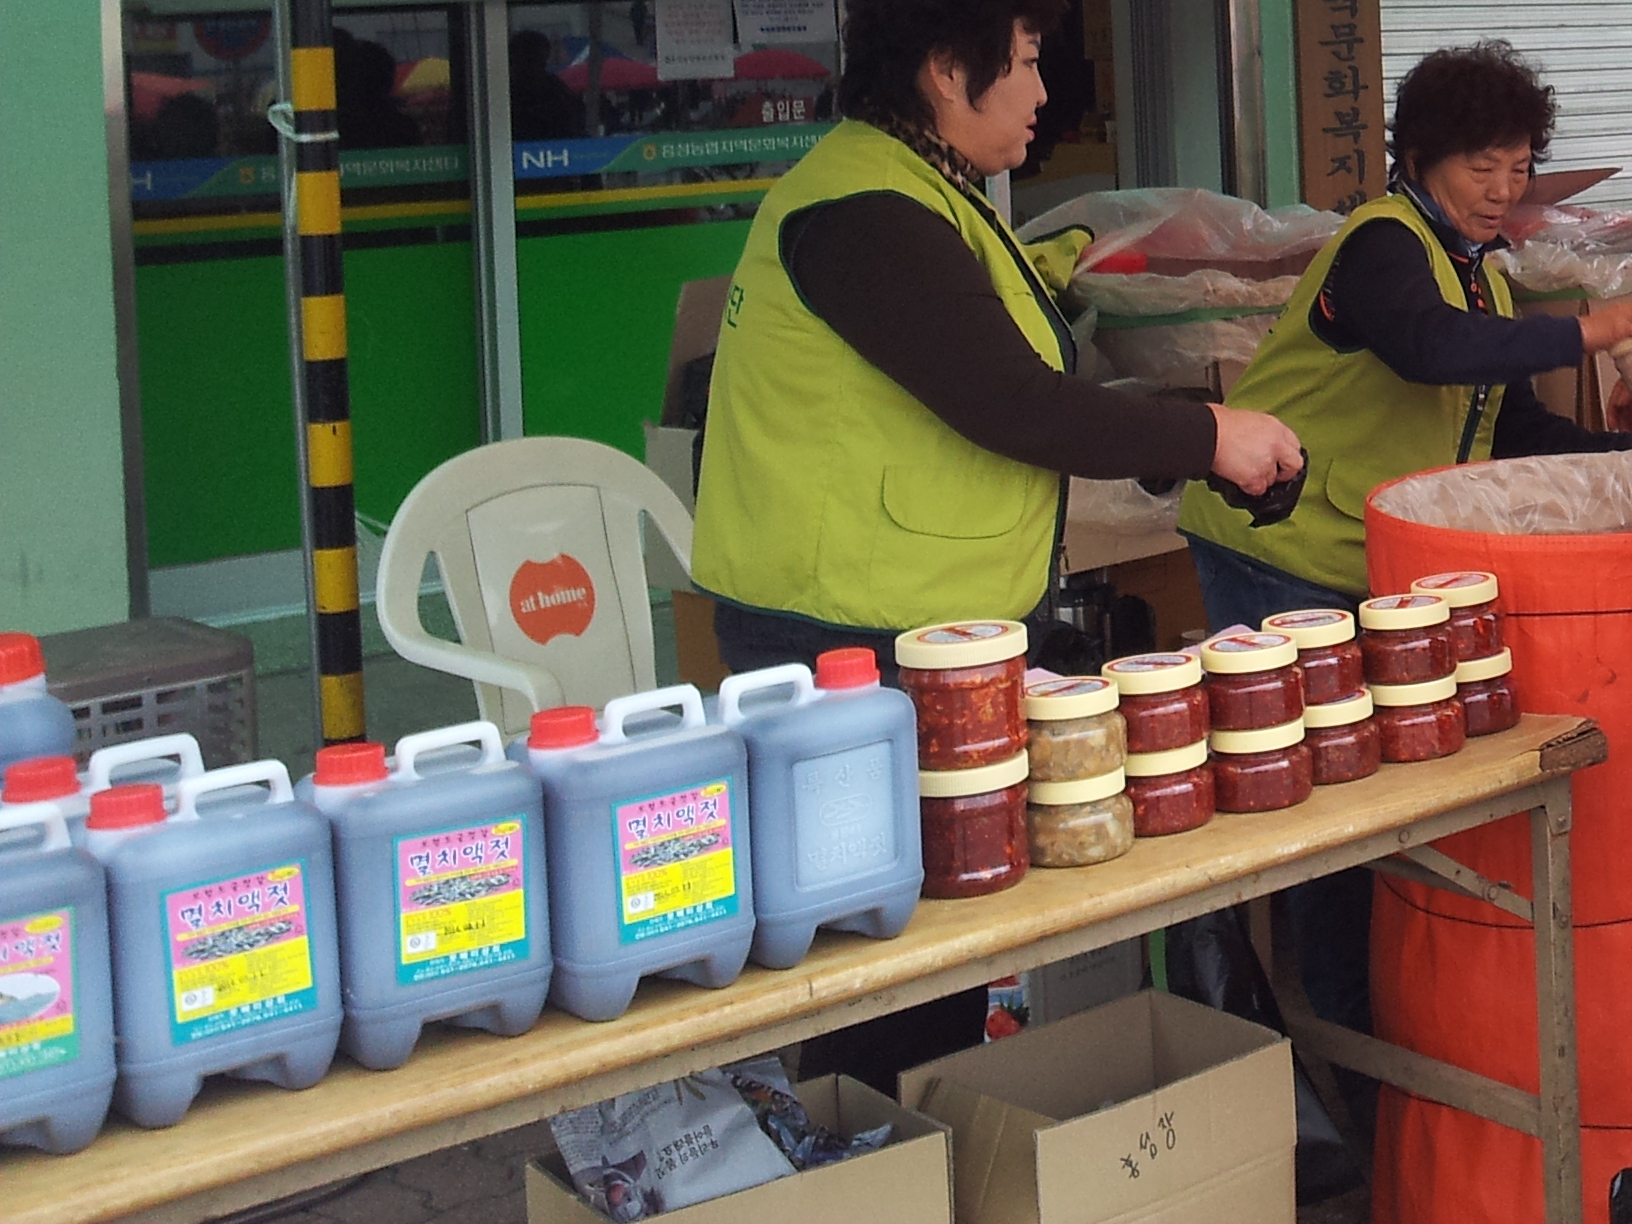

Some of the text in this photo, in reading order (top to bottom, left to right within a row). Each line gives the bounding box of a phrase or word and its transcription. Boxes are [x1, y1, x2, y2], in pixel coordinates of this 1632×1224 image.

[760, 99, 806, 122] 출입문
[521, 149, 569, 169] NH
[520, 586, 588, 614] at home
[628, 799, 718, 840] 멸치액젓
[409, 836, 510, 876] 멸치액젓
[180, 882, 289, 930] 멸치액젓
